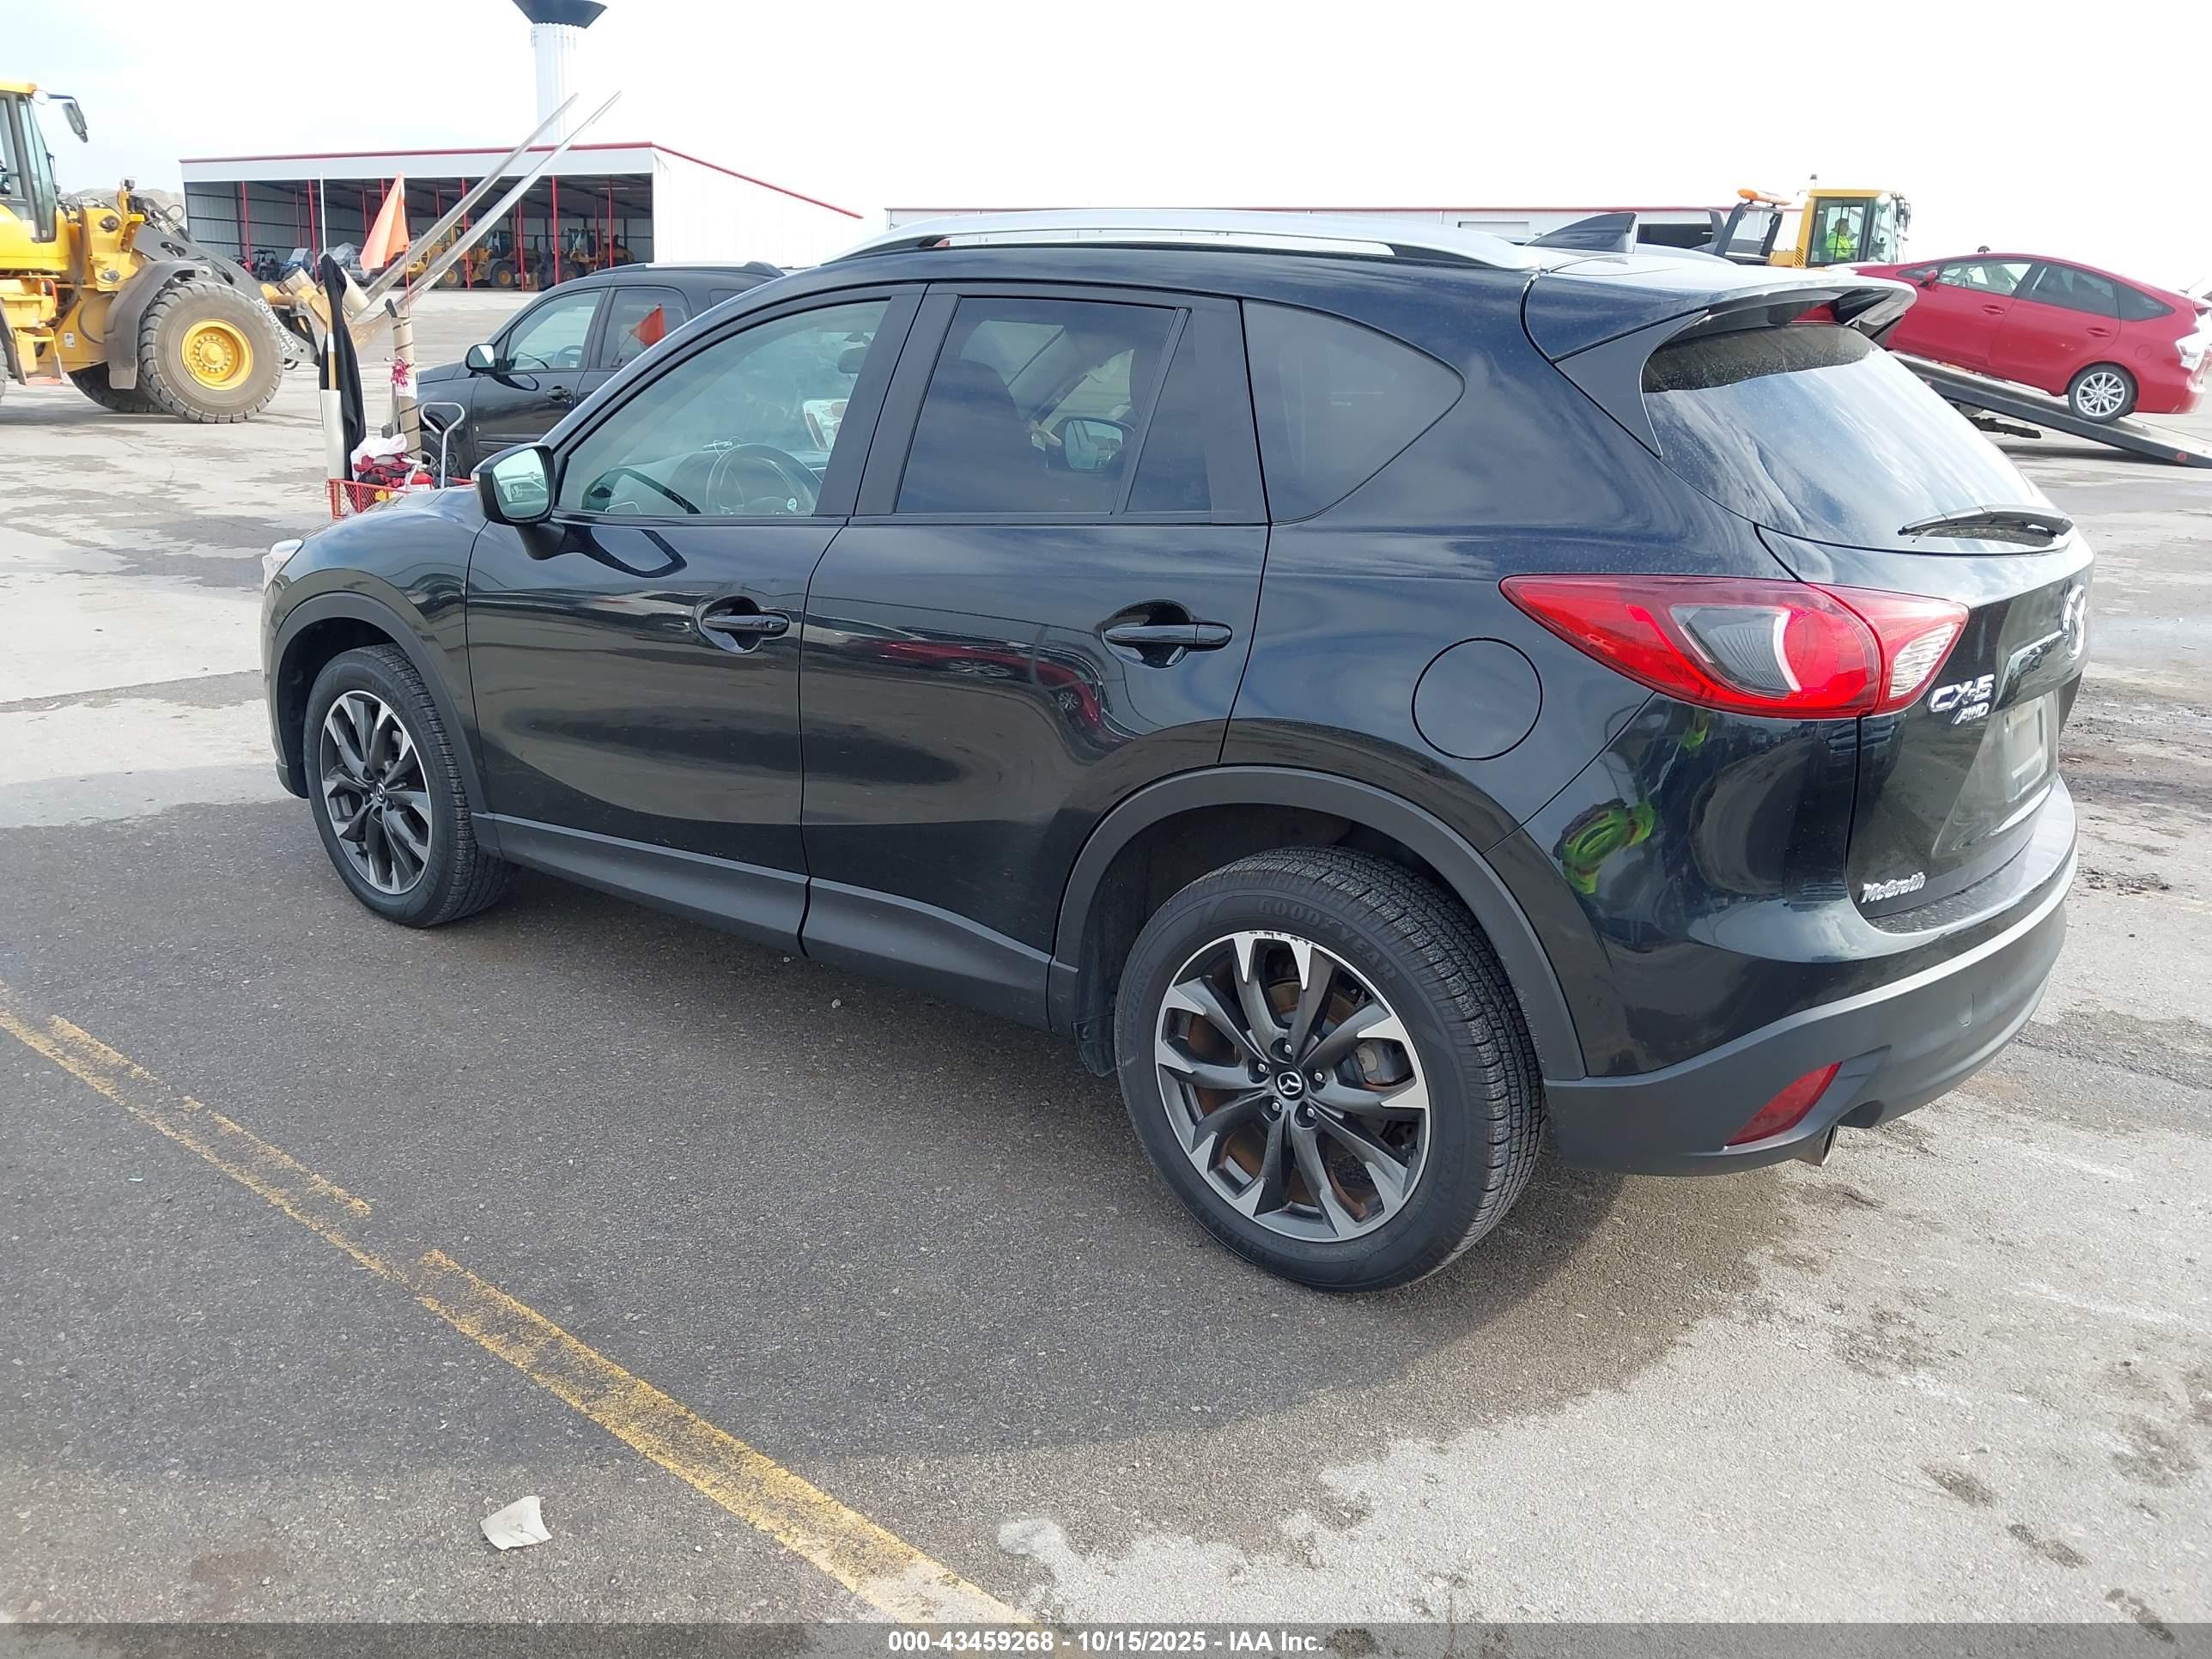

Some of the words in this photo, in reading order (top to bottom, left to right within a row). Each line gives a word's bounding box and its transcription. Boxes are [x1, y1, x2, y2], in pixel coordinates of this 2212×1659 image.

[257, 298, 269, 312] DO
[265, 310, 281, 327] NOT
[278, 326, 297, 349] WALK
[1929, 673, 1995, 713] CX-5
[1952, 702, 1990, 725] AWD
[1861, 872, 1926, 904] McGrath
